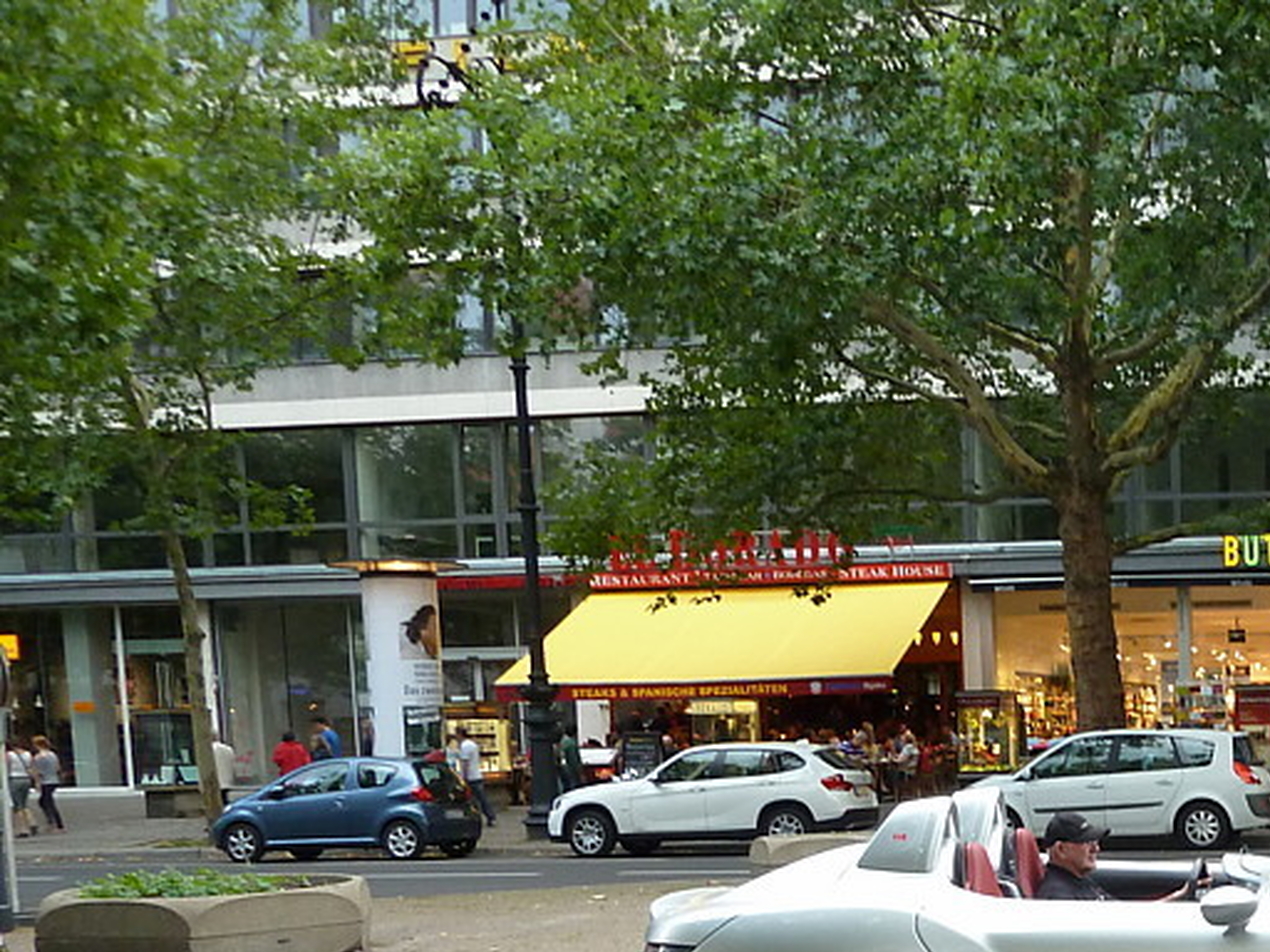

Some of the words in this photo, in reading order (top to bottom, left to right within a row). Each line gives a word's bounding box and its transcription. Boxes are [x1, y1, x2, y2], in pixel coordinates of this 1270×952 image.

[589, 573, 690, 588] RESTAURANT
[838, 566, 890, 579] STEAK
[892, 562, 945, 576] HOUSE
[572, 687, 618, 698] STEAKS
[620, 688, 629, 698] &
[632, 686, 696, 698] SPANISCHE
[699, 684, 788, 697] SPEZIALITÄTEN
